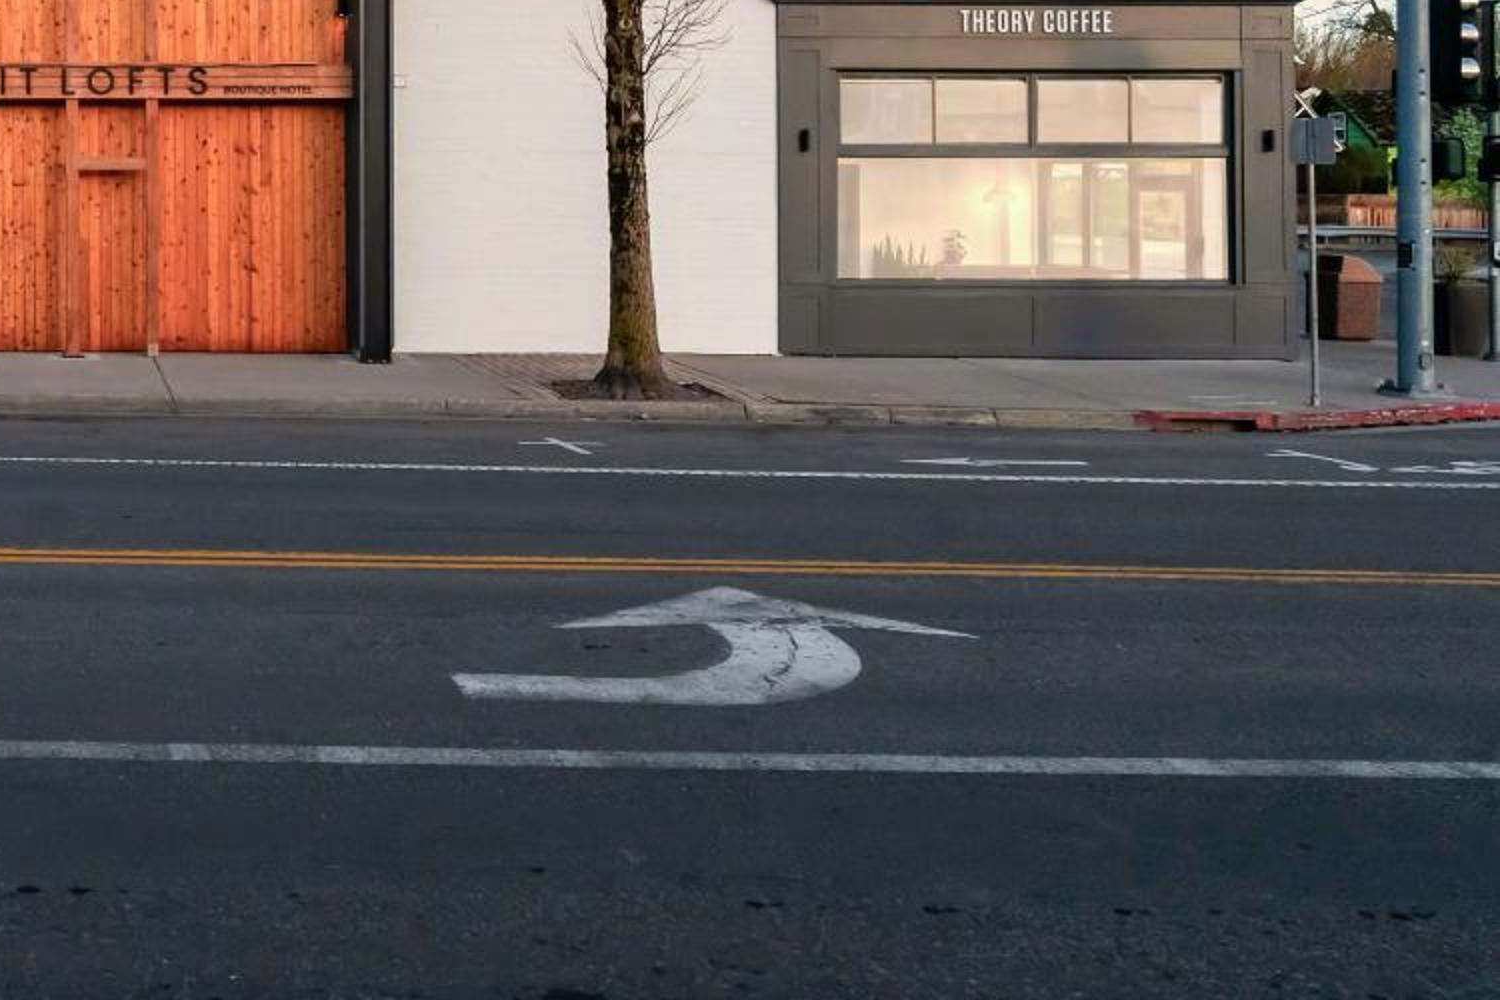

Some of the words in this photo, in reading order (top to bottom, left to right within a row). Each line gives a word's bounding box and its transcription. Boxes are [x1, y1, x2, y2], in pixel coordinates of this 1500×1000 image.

[960, 9, 1035, 33] THEORY
[1043, 9, 1114, 33] COFFEE
[61, 66, 208, 96] LOFTS
[223, 85, 277, 95] BOUTIQUE
[279, 85, 312, 95] HOTEL
